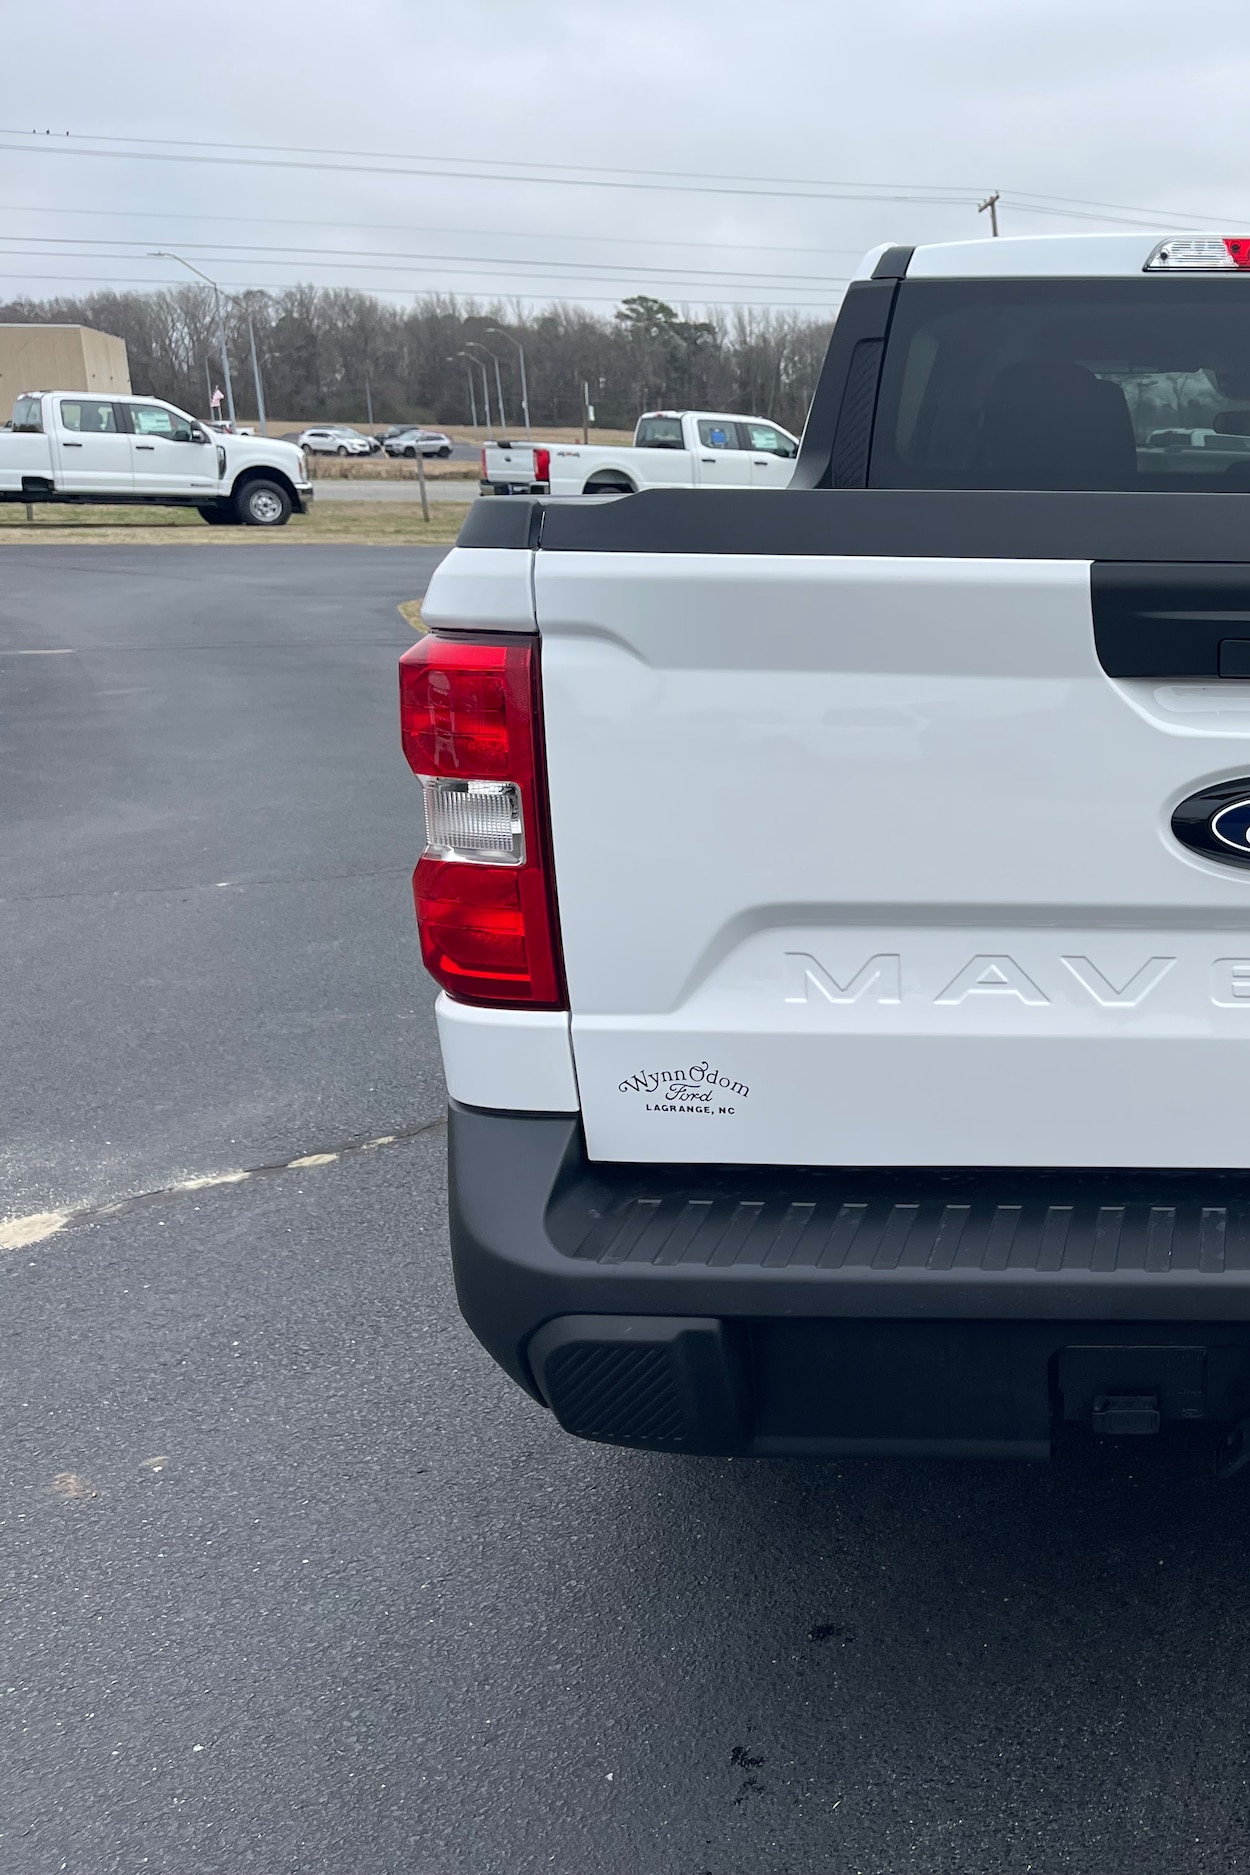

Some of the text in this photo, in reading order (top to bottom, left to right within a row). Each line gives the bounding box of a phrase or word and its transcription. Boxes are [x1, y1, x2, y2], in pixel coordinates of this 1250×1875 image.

[665, 1083, 713, 1102] Ford
[646, 1103, 736, 1115] LAGRANGE, NC
